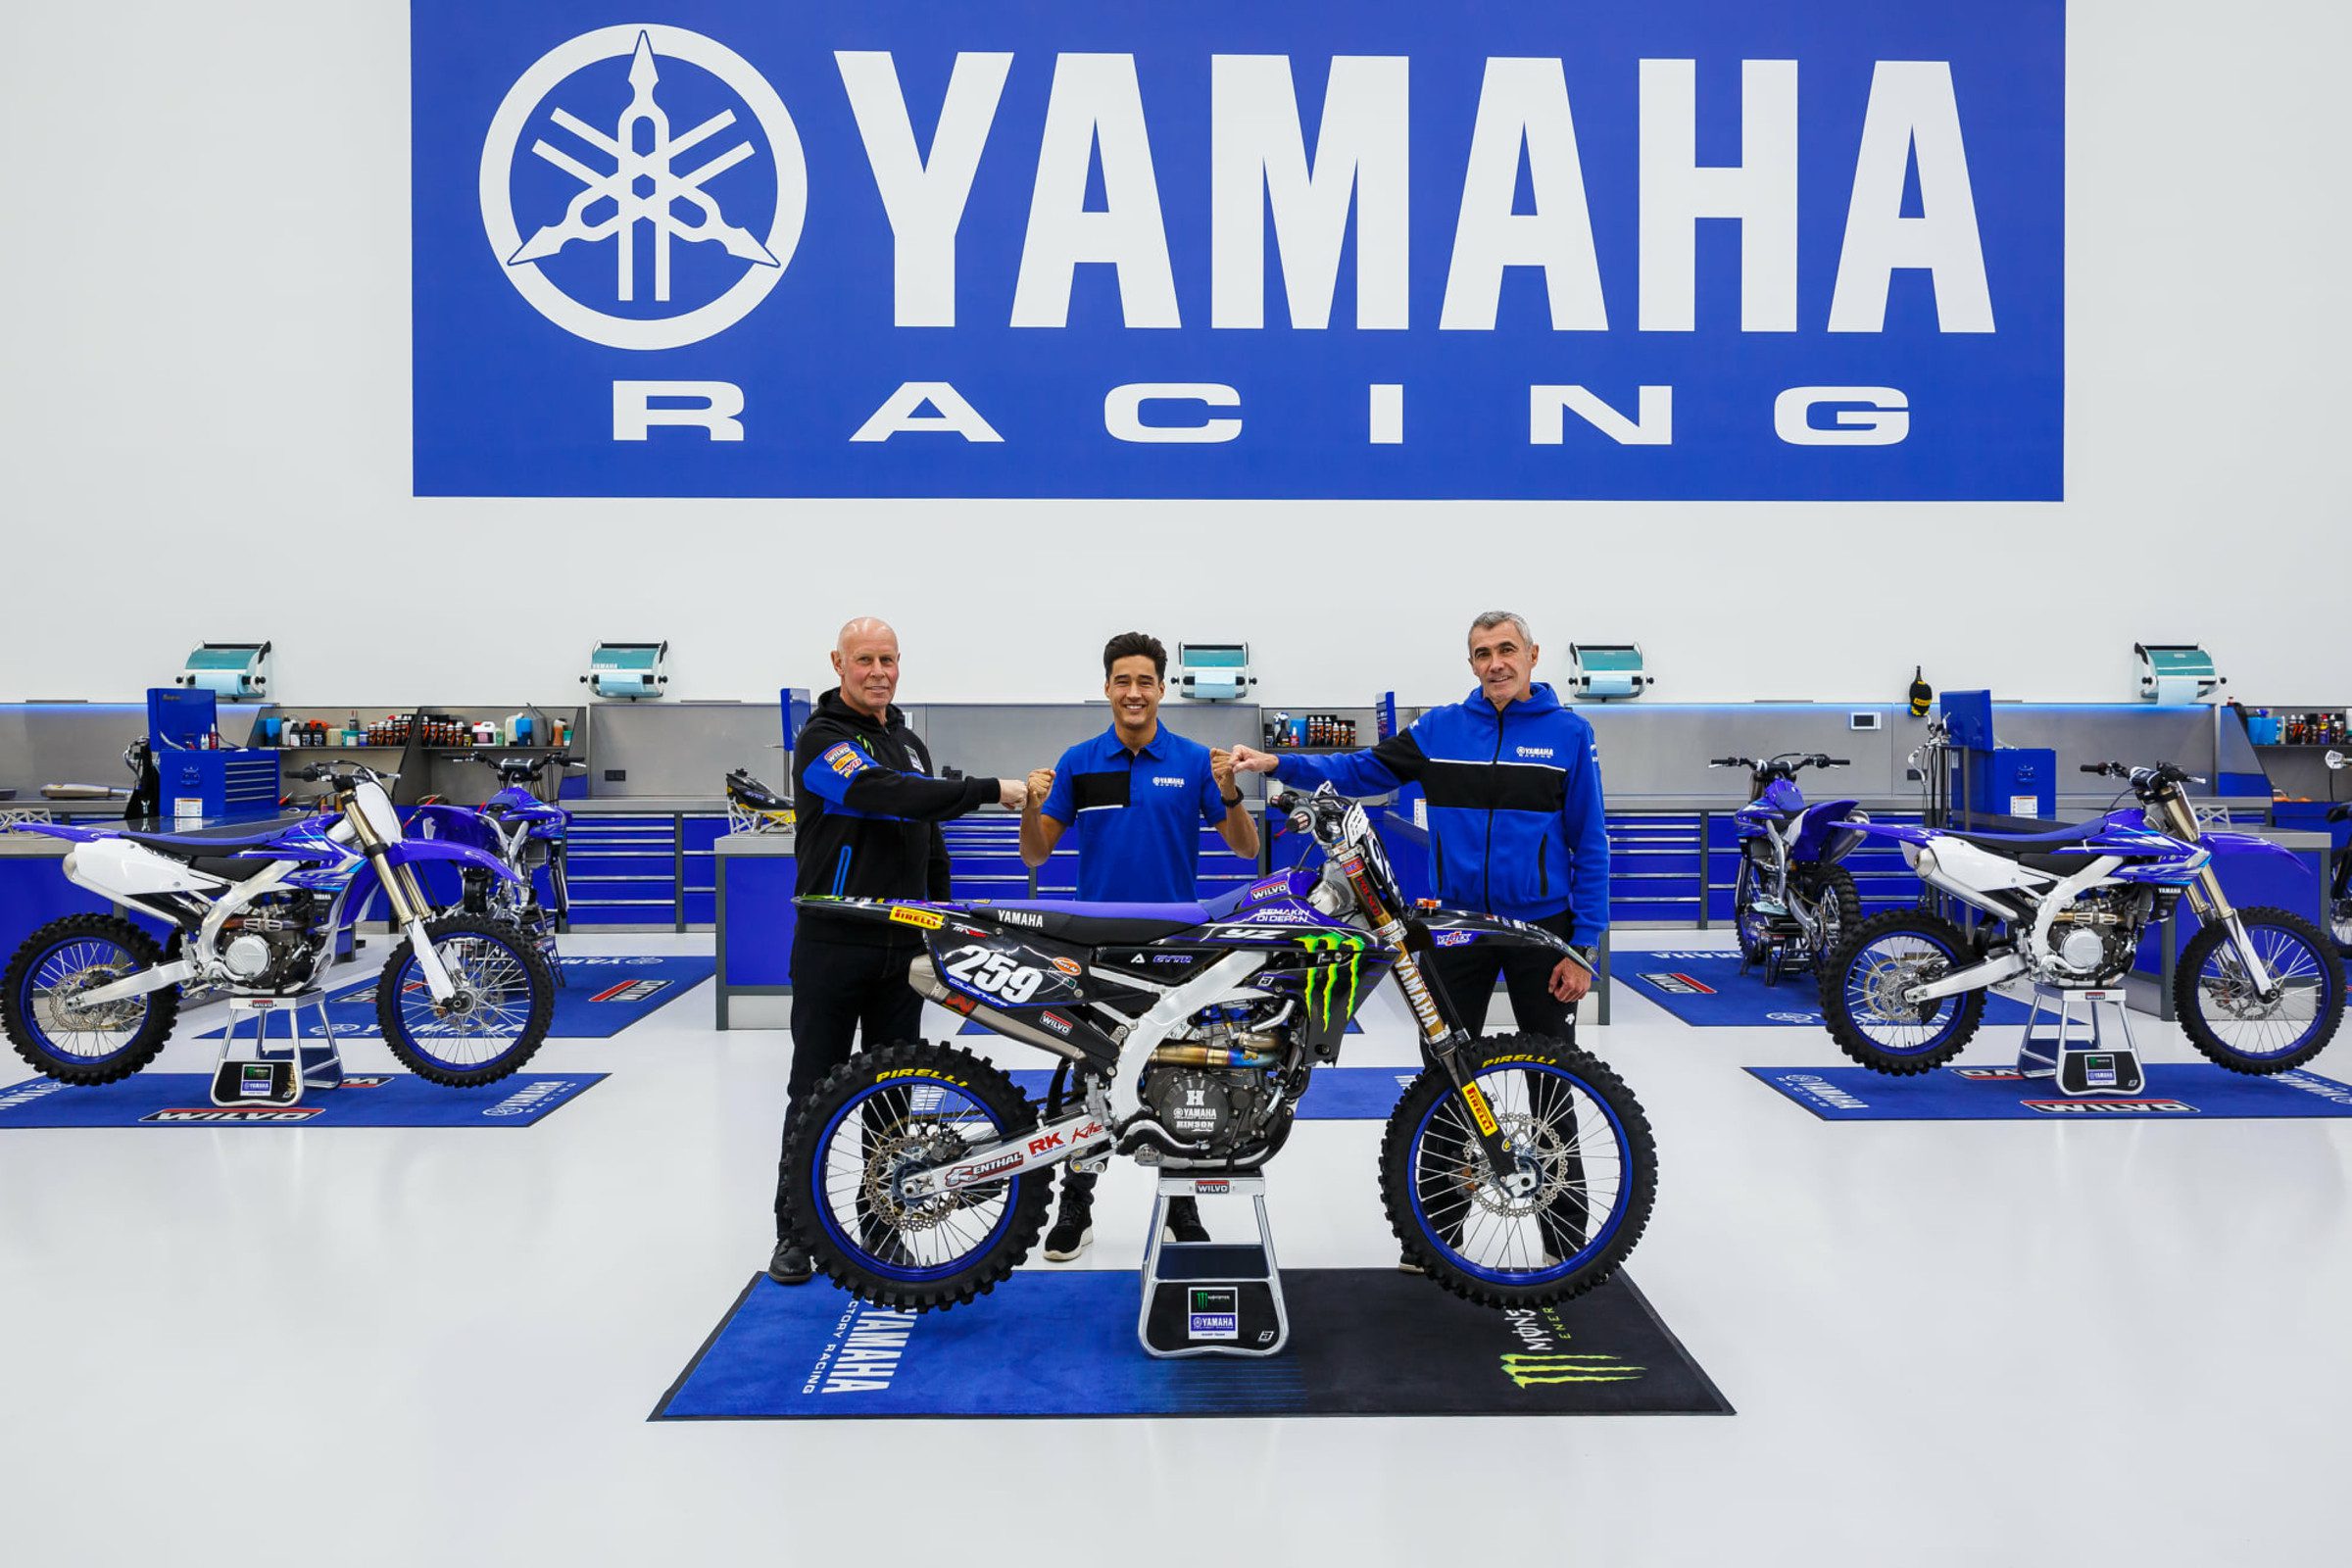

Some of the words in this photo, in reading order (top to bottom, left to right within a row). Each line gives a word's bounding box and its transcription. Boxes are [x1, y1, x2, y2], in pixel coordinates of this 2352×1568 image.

[834, 51, 1995, 332] YAMAHA
[612, 379, 1911, 447] RACING
[1526, 748, 1554, 757] YAMAHA
[1252, 884, 1287, 900] WILVO
[894, 908, 939, 927] PIRELLI
[997, 909, 1044, 928] YAMAHA
[946, 945, 1043, 1004] 259
[1395, 956, 1440, 1029] YAMAHA
[1042, 1016, 1070, 1034] WILVO
[1481, 1054, 1557, 1068] PIRELLI
[876, 1068, 969, 1087] PIRELLI
[1183, 1107, 1217, 1117] YAMAHA
[1466, 1087, 1494, 1131] PIRELLI
[2034, 1103, 2191, 1112] WILVO
[1176, 1120, 1215, 1130] HINSON
[1029, 1131, 1064, 1155] RK
[833, 1299, 859, 1338] CTORY
[1202, 1317, 1234, 1327] YAMAHA
[1543, 1306, 1572, 1340] ENER
[821, 1306, 918, 1394] YAMAHA
[802, 1344, 836, 1394] RACING
